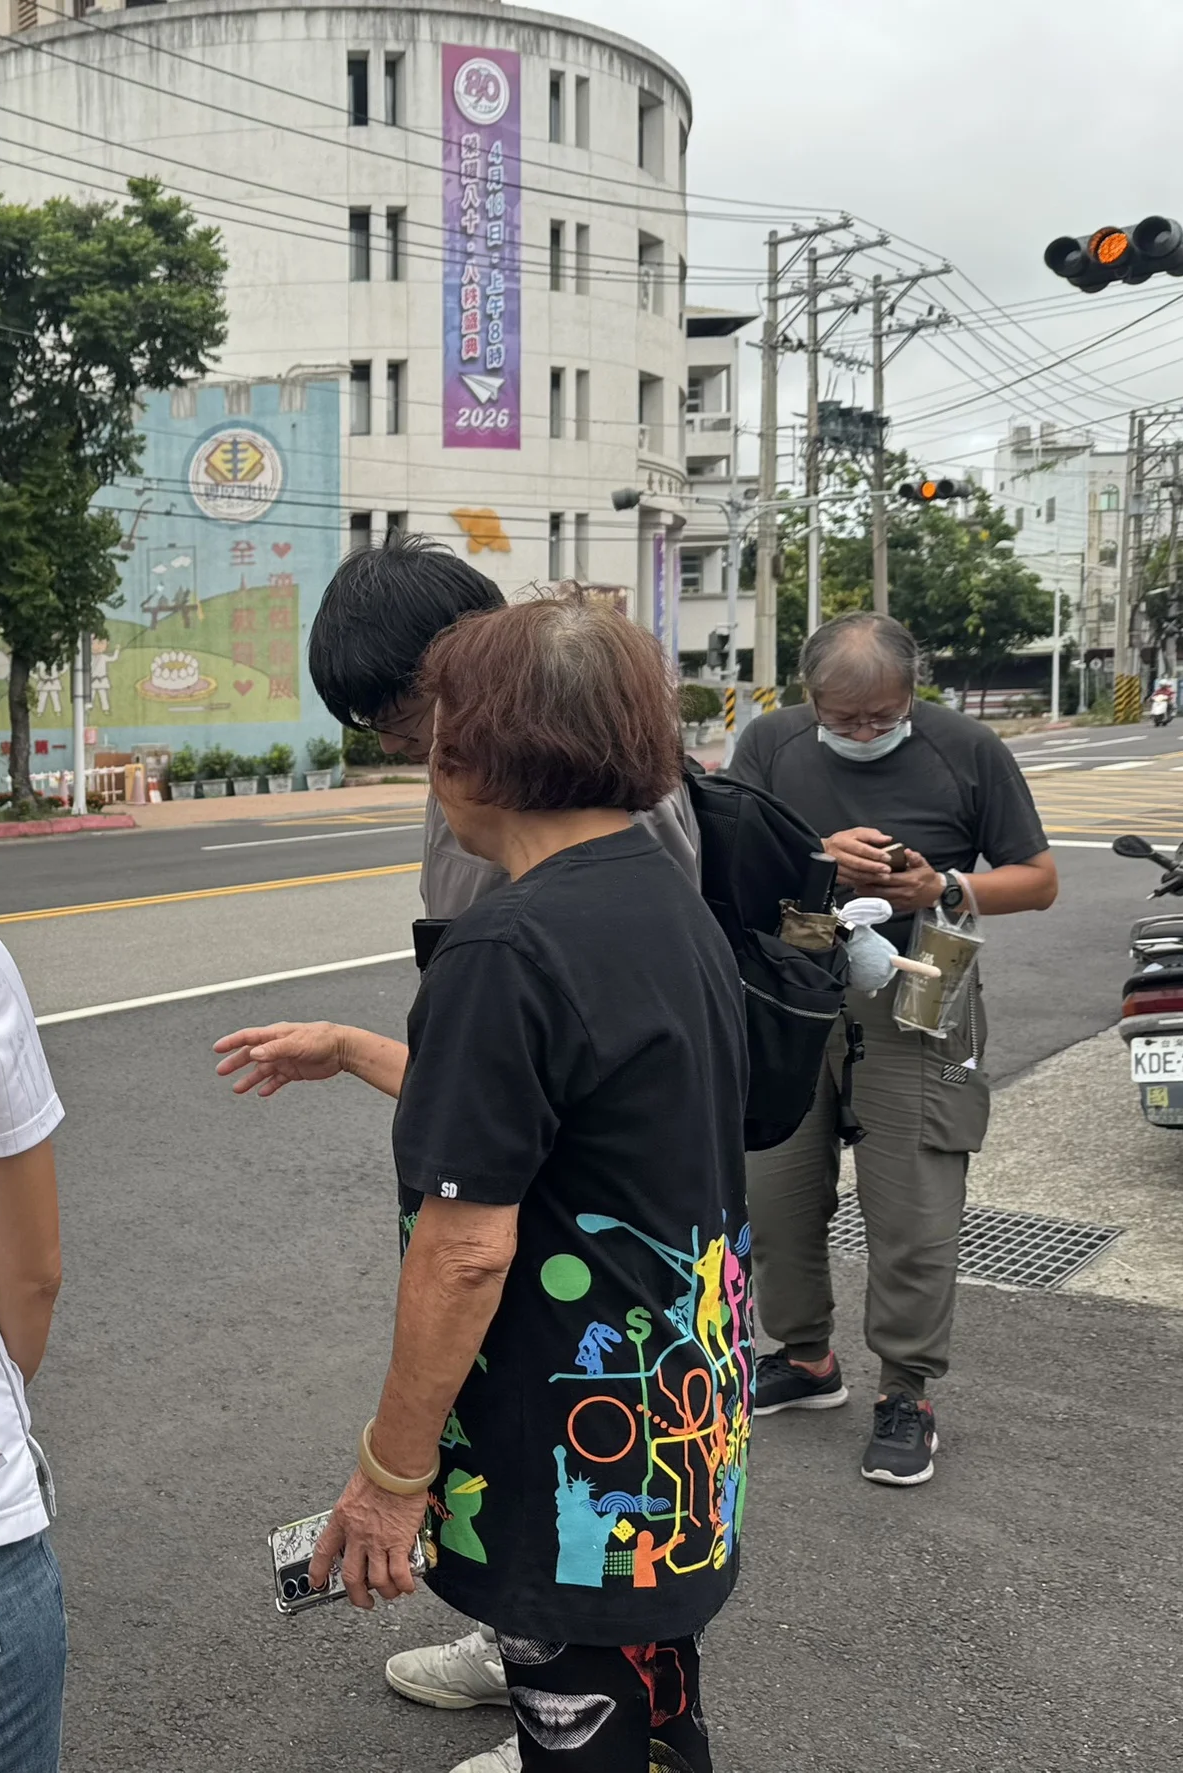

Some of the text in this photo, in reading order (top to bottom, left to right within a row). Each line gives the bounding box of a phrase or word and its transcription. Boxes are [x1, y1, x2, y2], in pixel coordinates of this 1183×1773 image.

[456, 408, 509, 428] 2026
[1135, 1051, 1183, 1074] KDE-
[440, 1181, 458, 1198] SD
